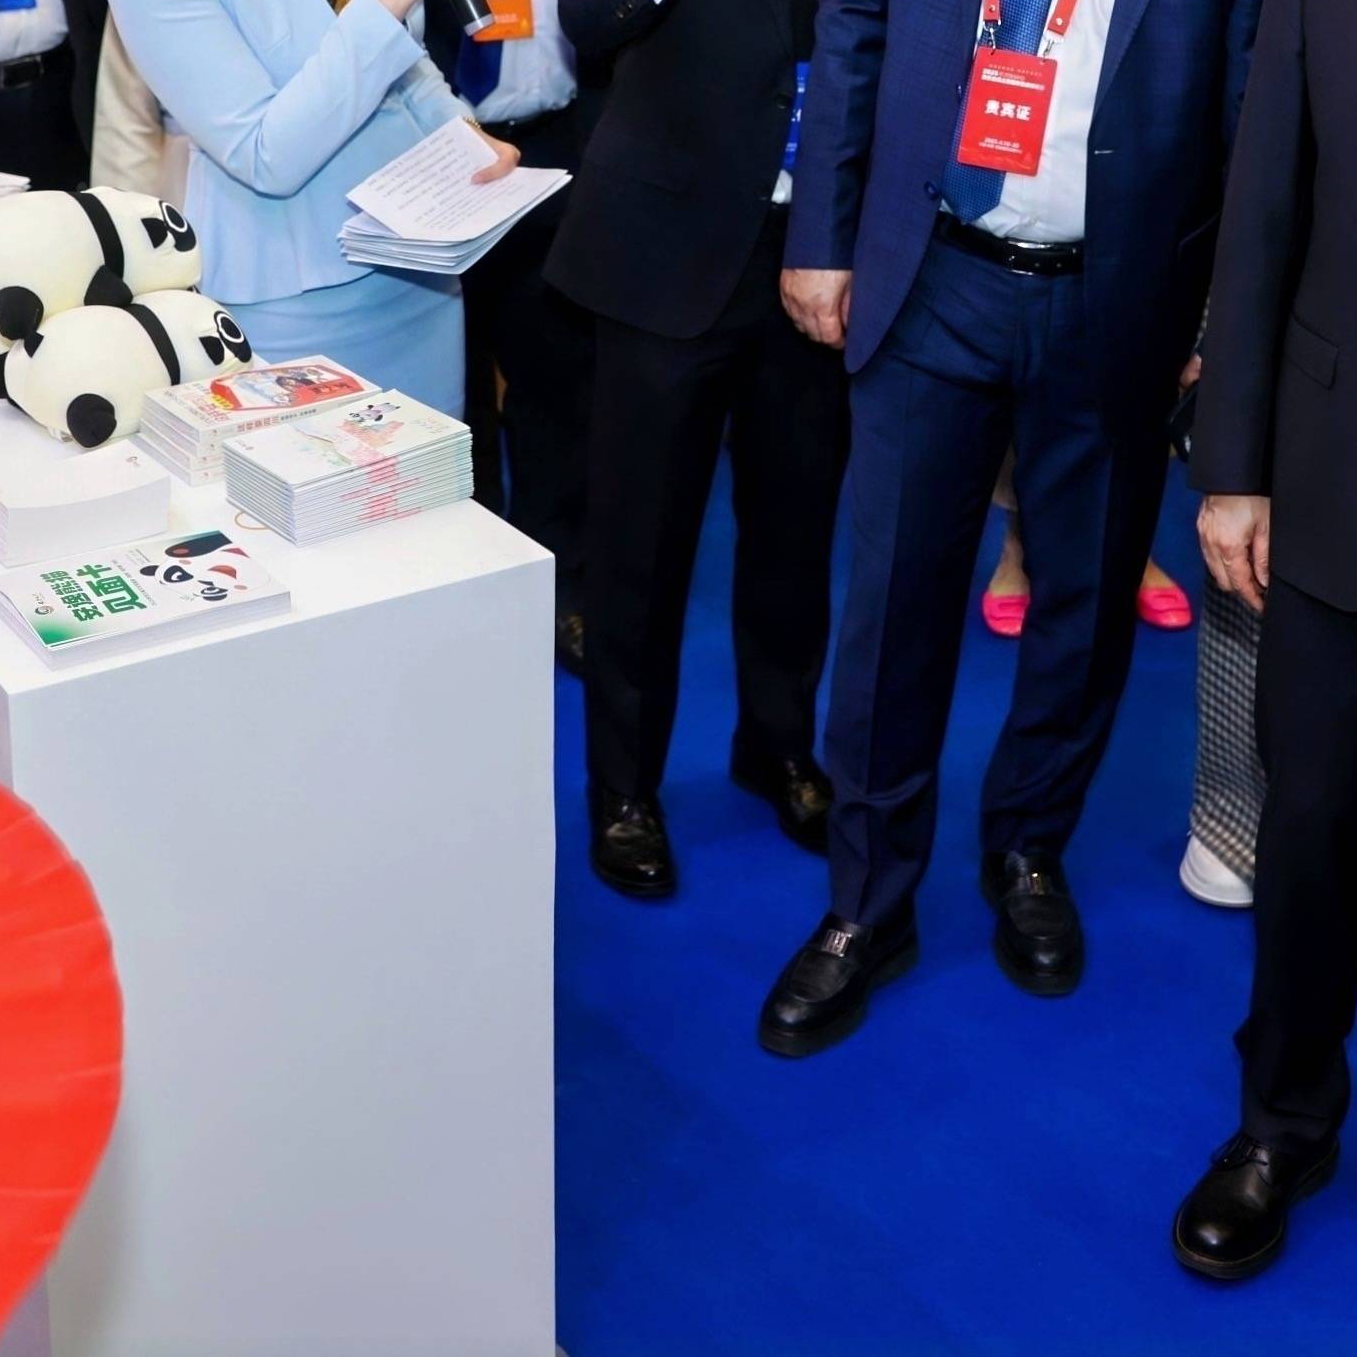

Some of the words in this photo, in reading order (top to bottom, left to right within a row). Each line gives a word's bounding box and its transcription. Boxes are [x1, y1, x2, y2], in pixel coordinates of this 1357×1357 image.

[984, 99, 1031, 121] 贵宾证
[39, 570, 104, 622] 安逸熊猫
[76, 564, 148, 614] 见面卡
